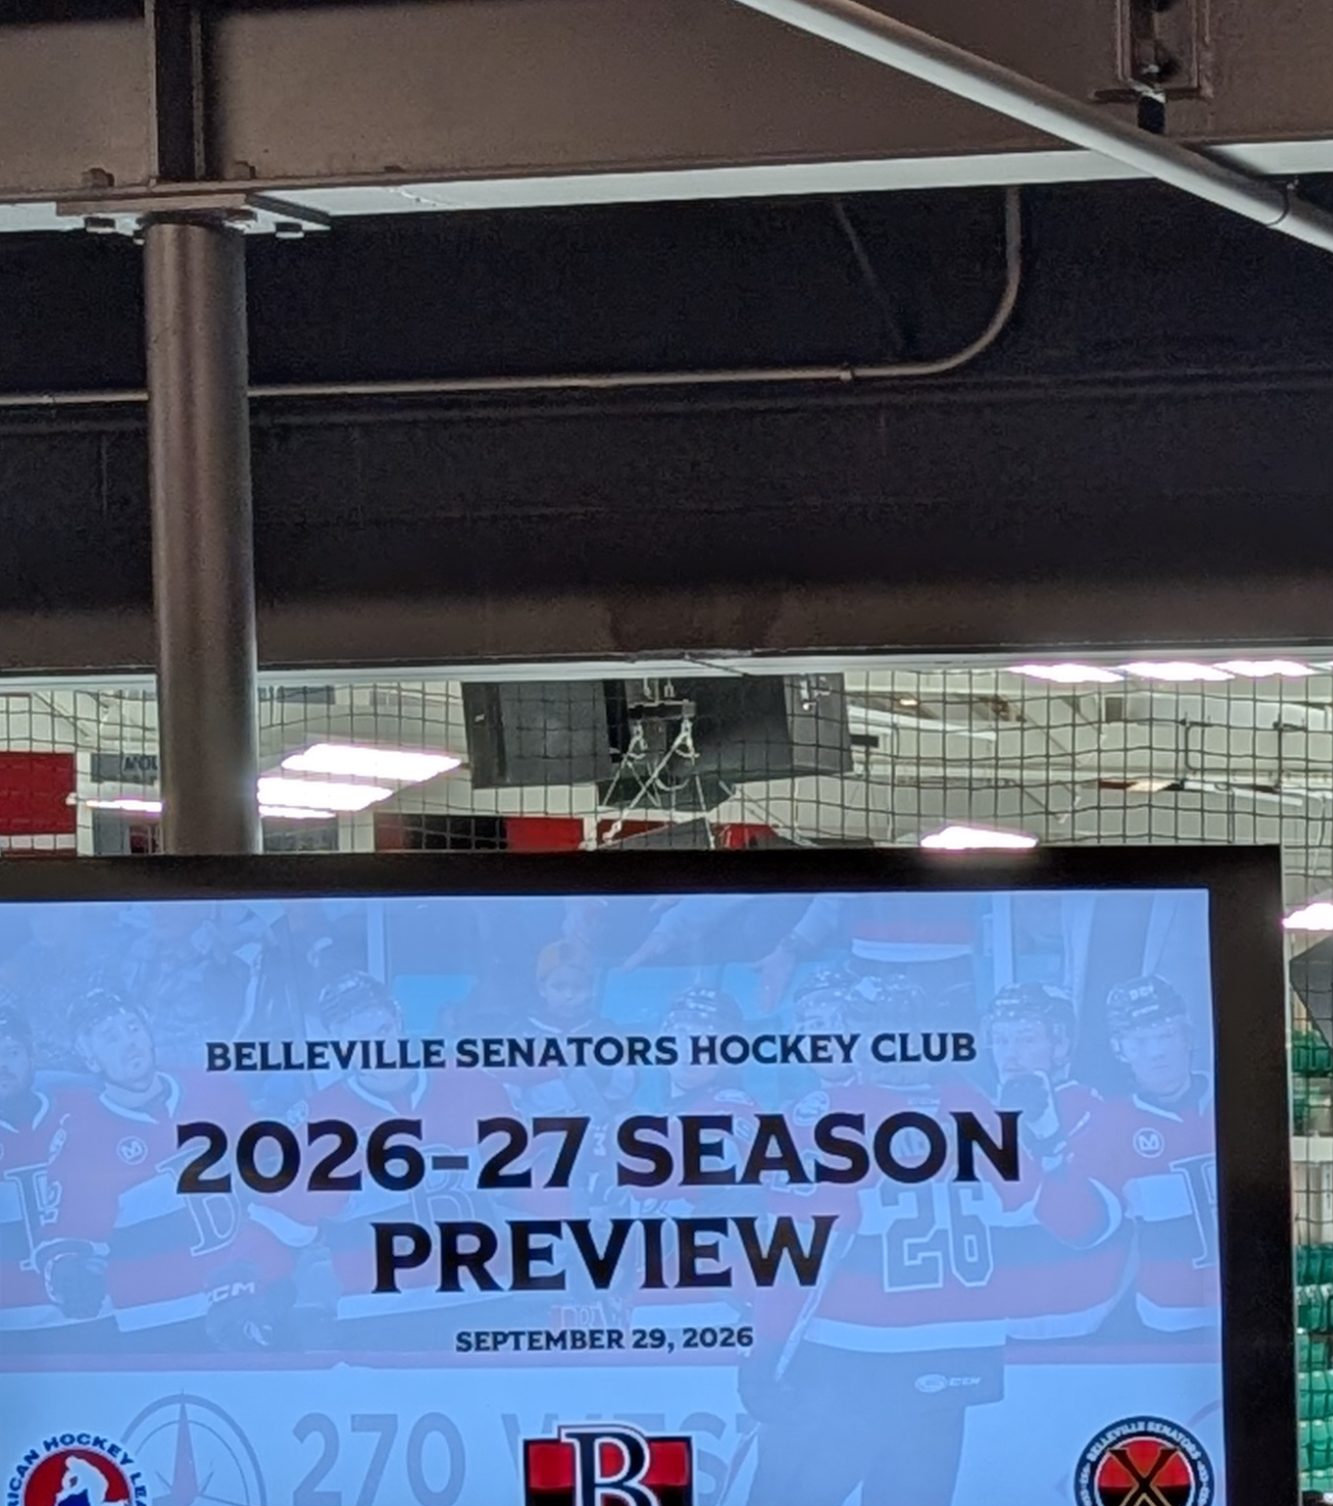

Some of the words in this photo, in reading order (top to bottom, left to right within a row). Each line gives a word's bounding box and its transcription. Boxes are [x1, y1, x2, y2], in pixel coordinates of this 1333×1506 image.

[207, 1040, 445, 1071] BELLEVILLE
[457, 1037, 677, 1067] SENATORS
[691, 1034, 857, 1065] HOCKEY
[871, 1033, 976, 1062] CLUB
[177, 1117, 590, 1193] 2026-27
[617, 1111, 1021, 1188] SEASON
[371, 1216, 838, 1293] PREVIEW
[456, 1329, 624, 1352] SEPTEMBER
[633, 1329, 675, 1354] 29,
[682, 1327, 753, 1348] 2026
[43, 1433, 134, 1466] HOCKEY
